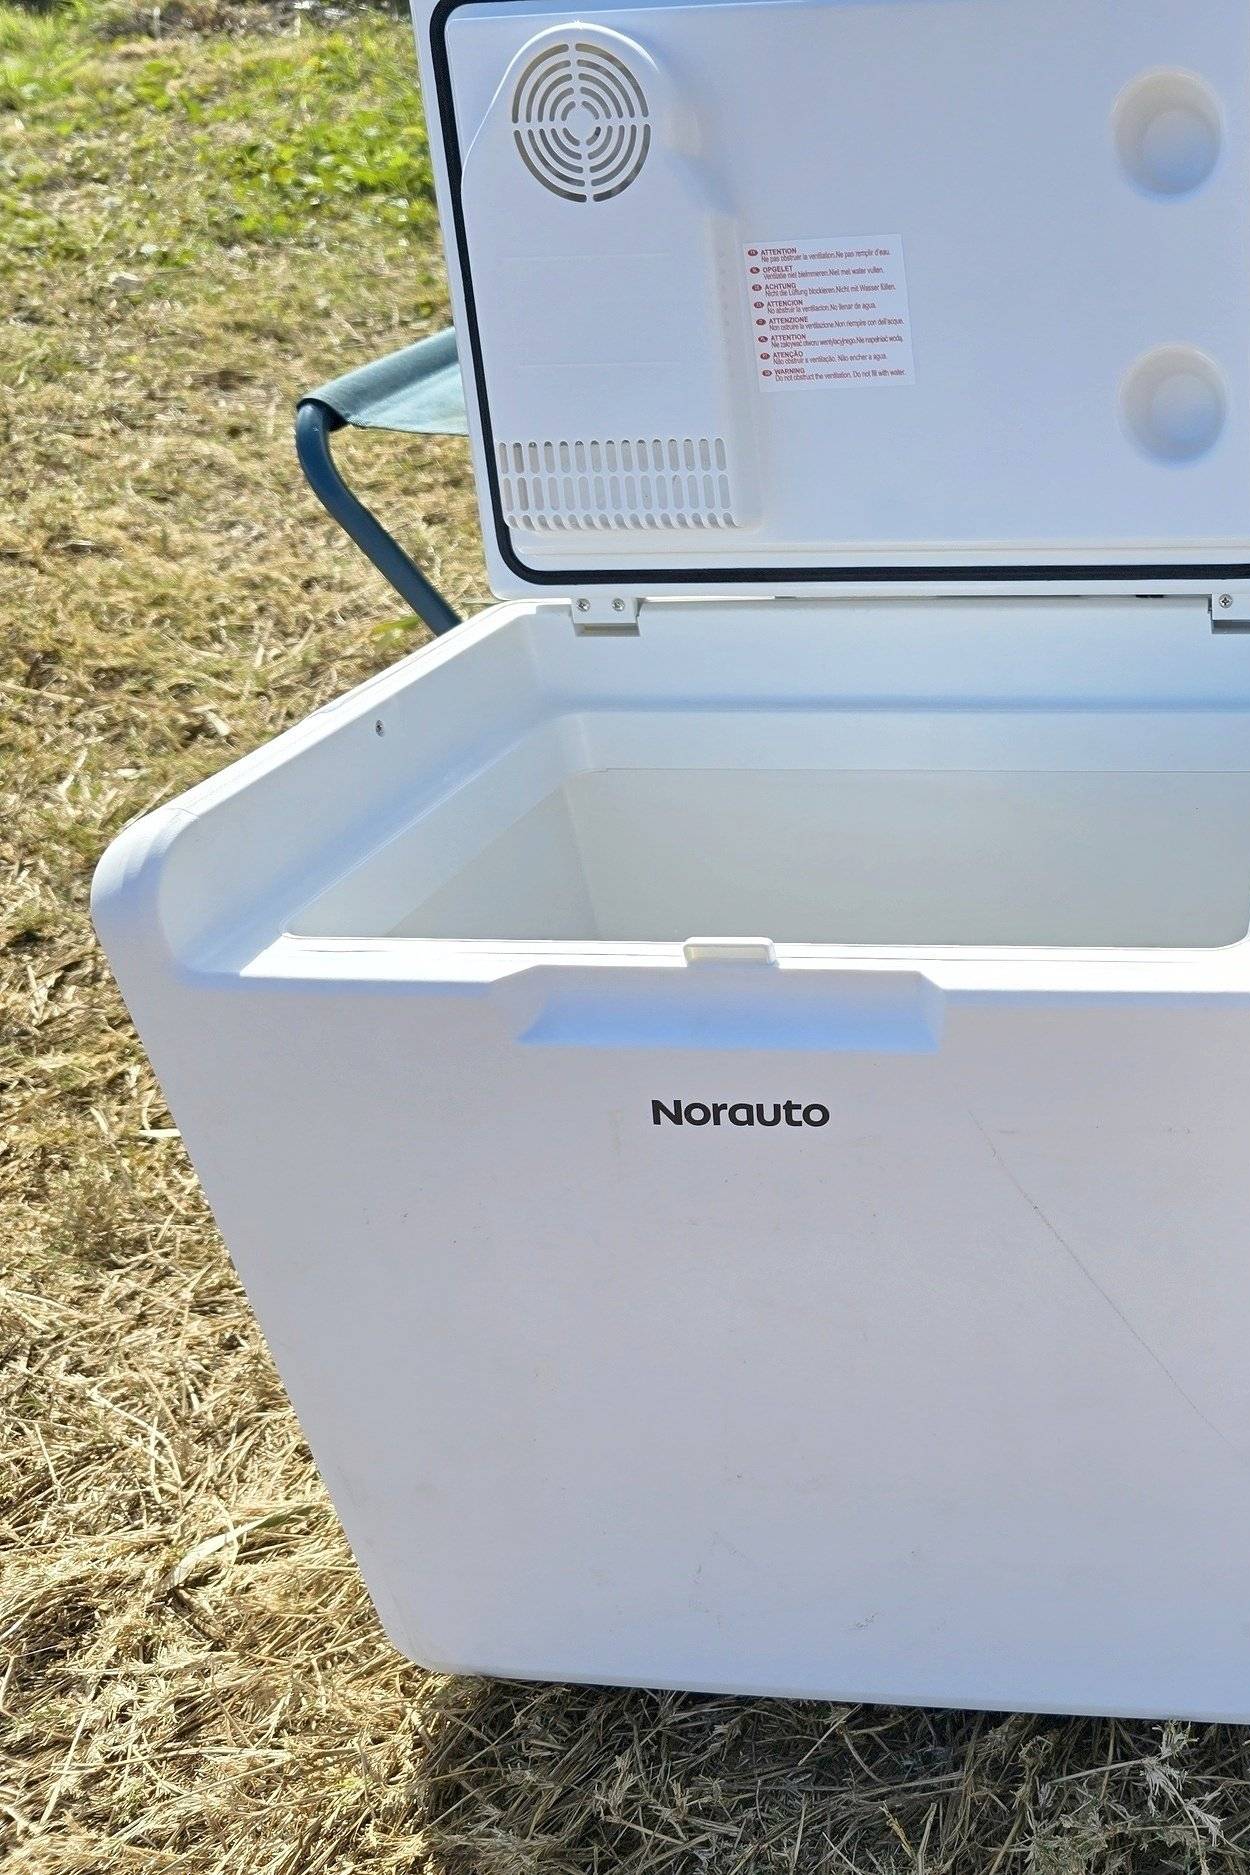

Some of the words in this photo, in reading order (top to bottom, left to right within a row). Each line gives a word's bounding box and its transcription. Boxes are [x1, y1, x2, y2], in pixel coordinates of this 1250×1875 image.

[760, 248, 797, 256] ATTENTION
[762, 265, 793, 273] OPGELET
[765, 282, 796, 290] ACHTUNG
[769, 316, 808, 325] ATTENZIONE
[771, 334, 806, 342] ATTENTION
[774, 367, 805, 375] WARNING
[651, 1099, 830, 1127] Norauto
